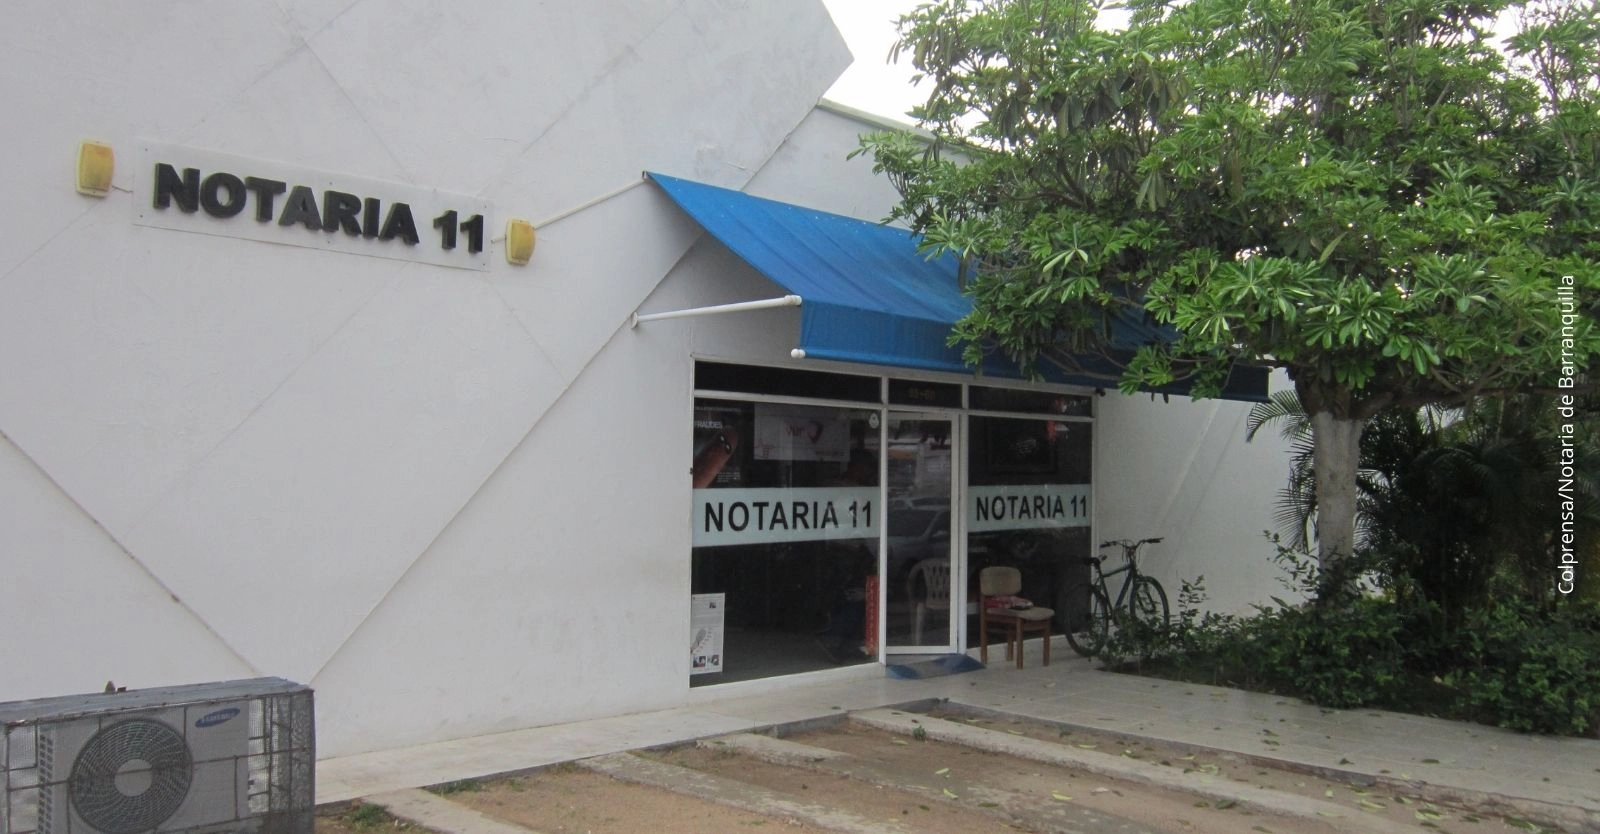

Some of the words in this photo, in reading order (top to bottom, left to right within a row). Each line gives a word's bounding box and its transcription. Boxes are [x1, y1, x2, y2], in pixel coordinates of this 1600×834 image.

[153, 162, 420, 246] NOTARIA
[433, 209, 484, 254] 11
[704, 501, 839, 533] NOTARIA
[848, 500, 872, 528] 11
[976, 495, 1065, 521] NOTARIA
[1070, 495, 1087, 517] 11
